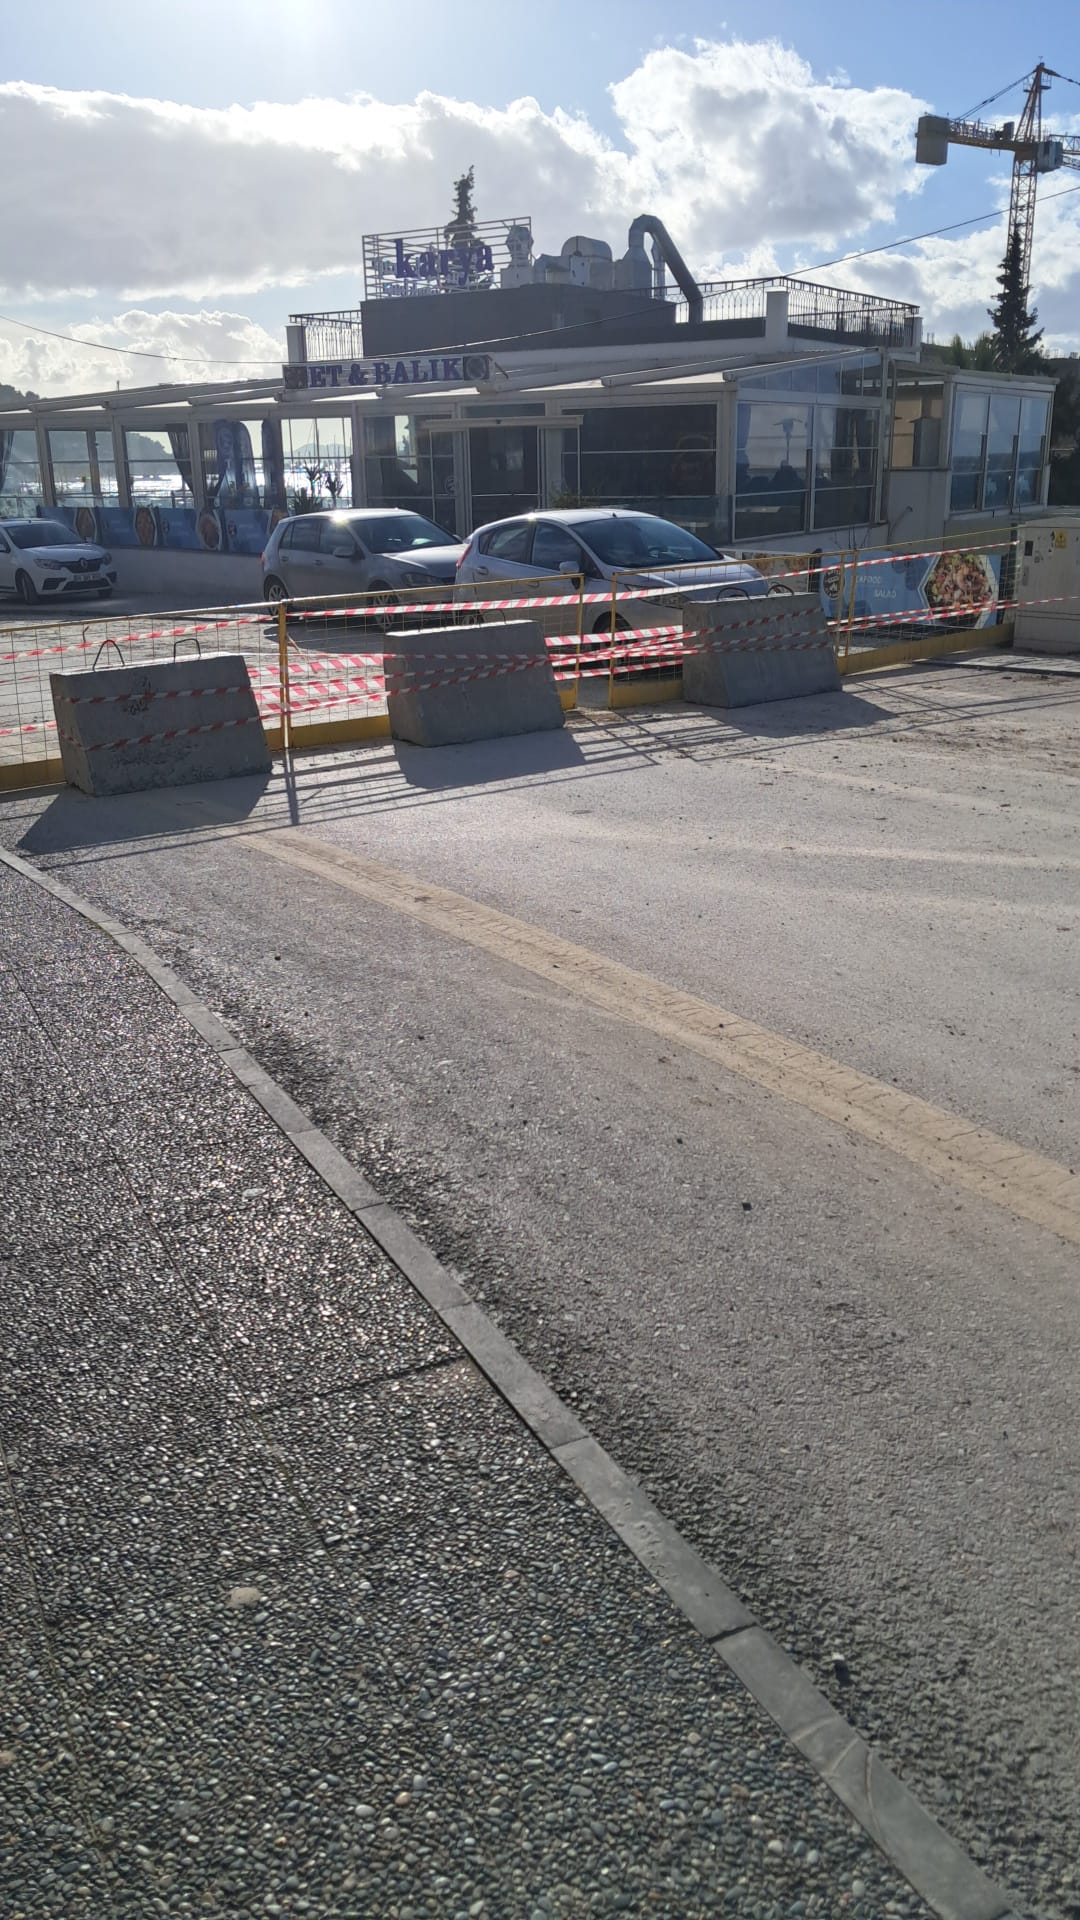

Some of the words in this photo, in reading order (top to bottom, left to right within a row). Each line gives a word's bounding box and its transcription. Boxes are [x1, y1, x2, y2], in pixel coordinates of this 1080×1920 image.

[395, 239, 494, 287] karya
[308, 365, 342, 388] ET
[349, 363, 369, 385] &
[373, 358, 463, 384] BALIK
